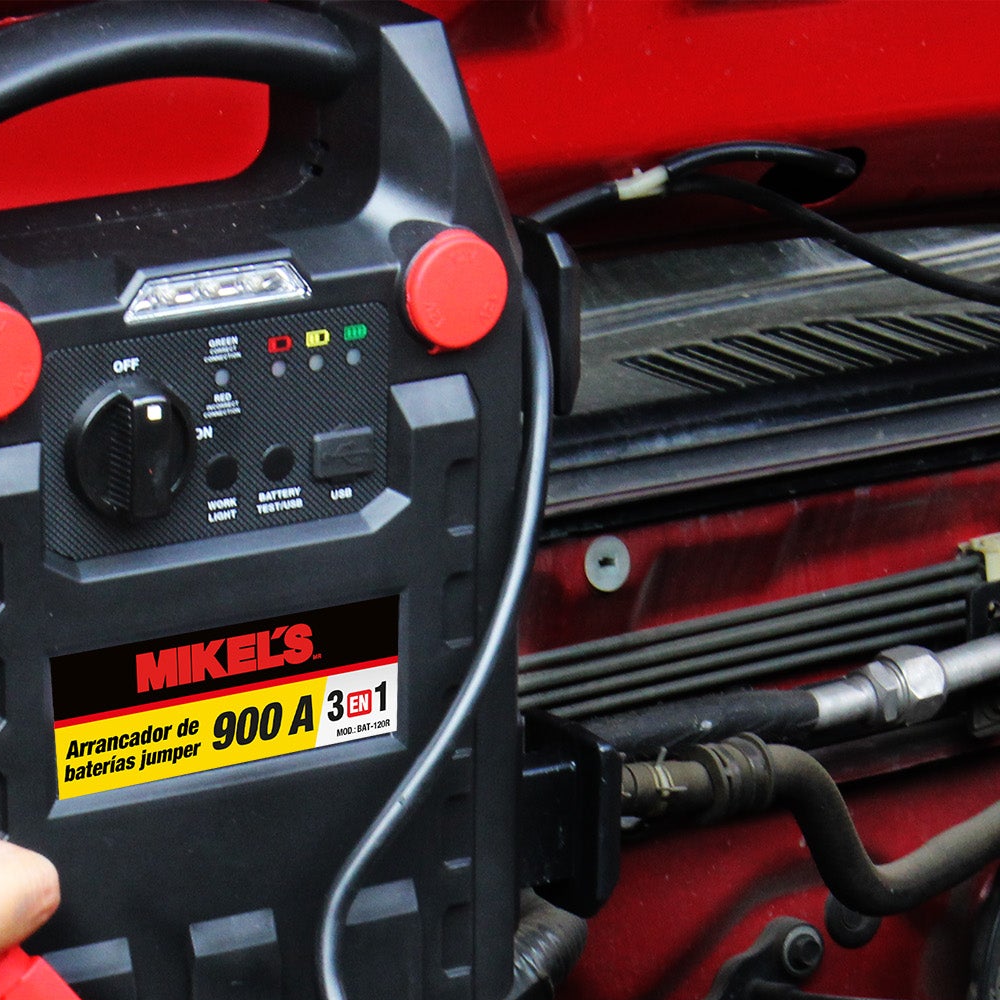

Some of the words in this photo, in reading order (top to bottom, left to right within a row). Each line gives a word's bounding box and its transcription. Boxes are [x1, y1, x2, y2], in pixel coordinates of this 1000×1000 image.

[208, 336, 239, 348] GREEN
[112, 357, 140, 374] OFF
[213, 392, 232, 403] RED
[258, 486, 301, 502] BATTERY
[330, 487, 353, 500] USB
[207, 497, 237, 511] WORK
[256, 497, 303, 514] TEST/USB
[207, 509, 237, 523] LIGHT
[327, 689, 344, 722] 3
[349, 693, 370, 714] EN
[374, 680, 387, 712] 1
[212, 702, 283, 751] 900
[288, 694, 314, 736] A
[336, 725, 357, 737] MOD.:
[357, 719, 391, 733] BAT-120R
[66, 725, 172, 760] Arrancador
[177, 718, 199, 737] de
[64, 755, 136, 782] baterías
[139, 742, 201, 771] jumper
